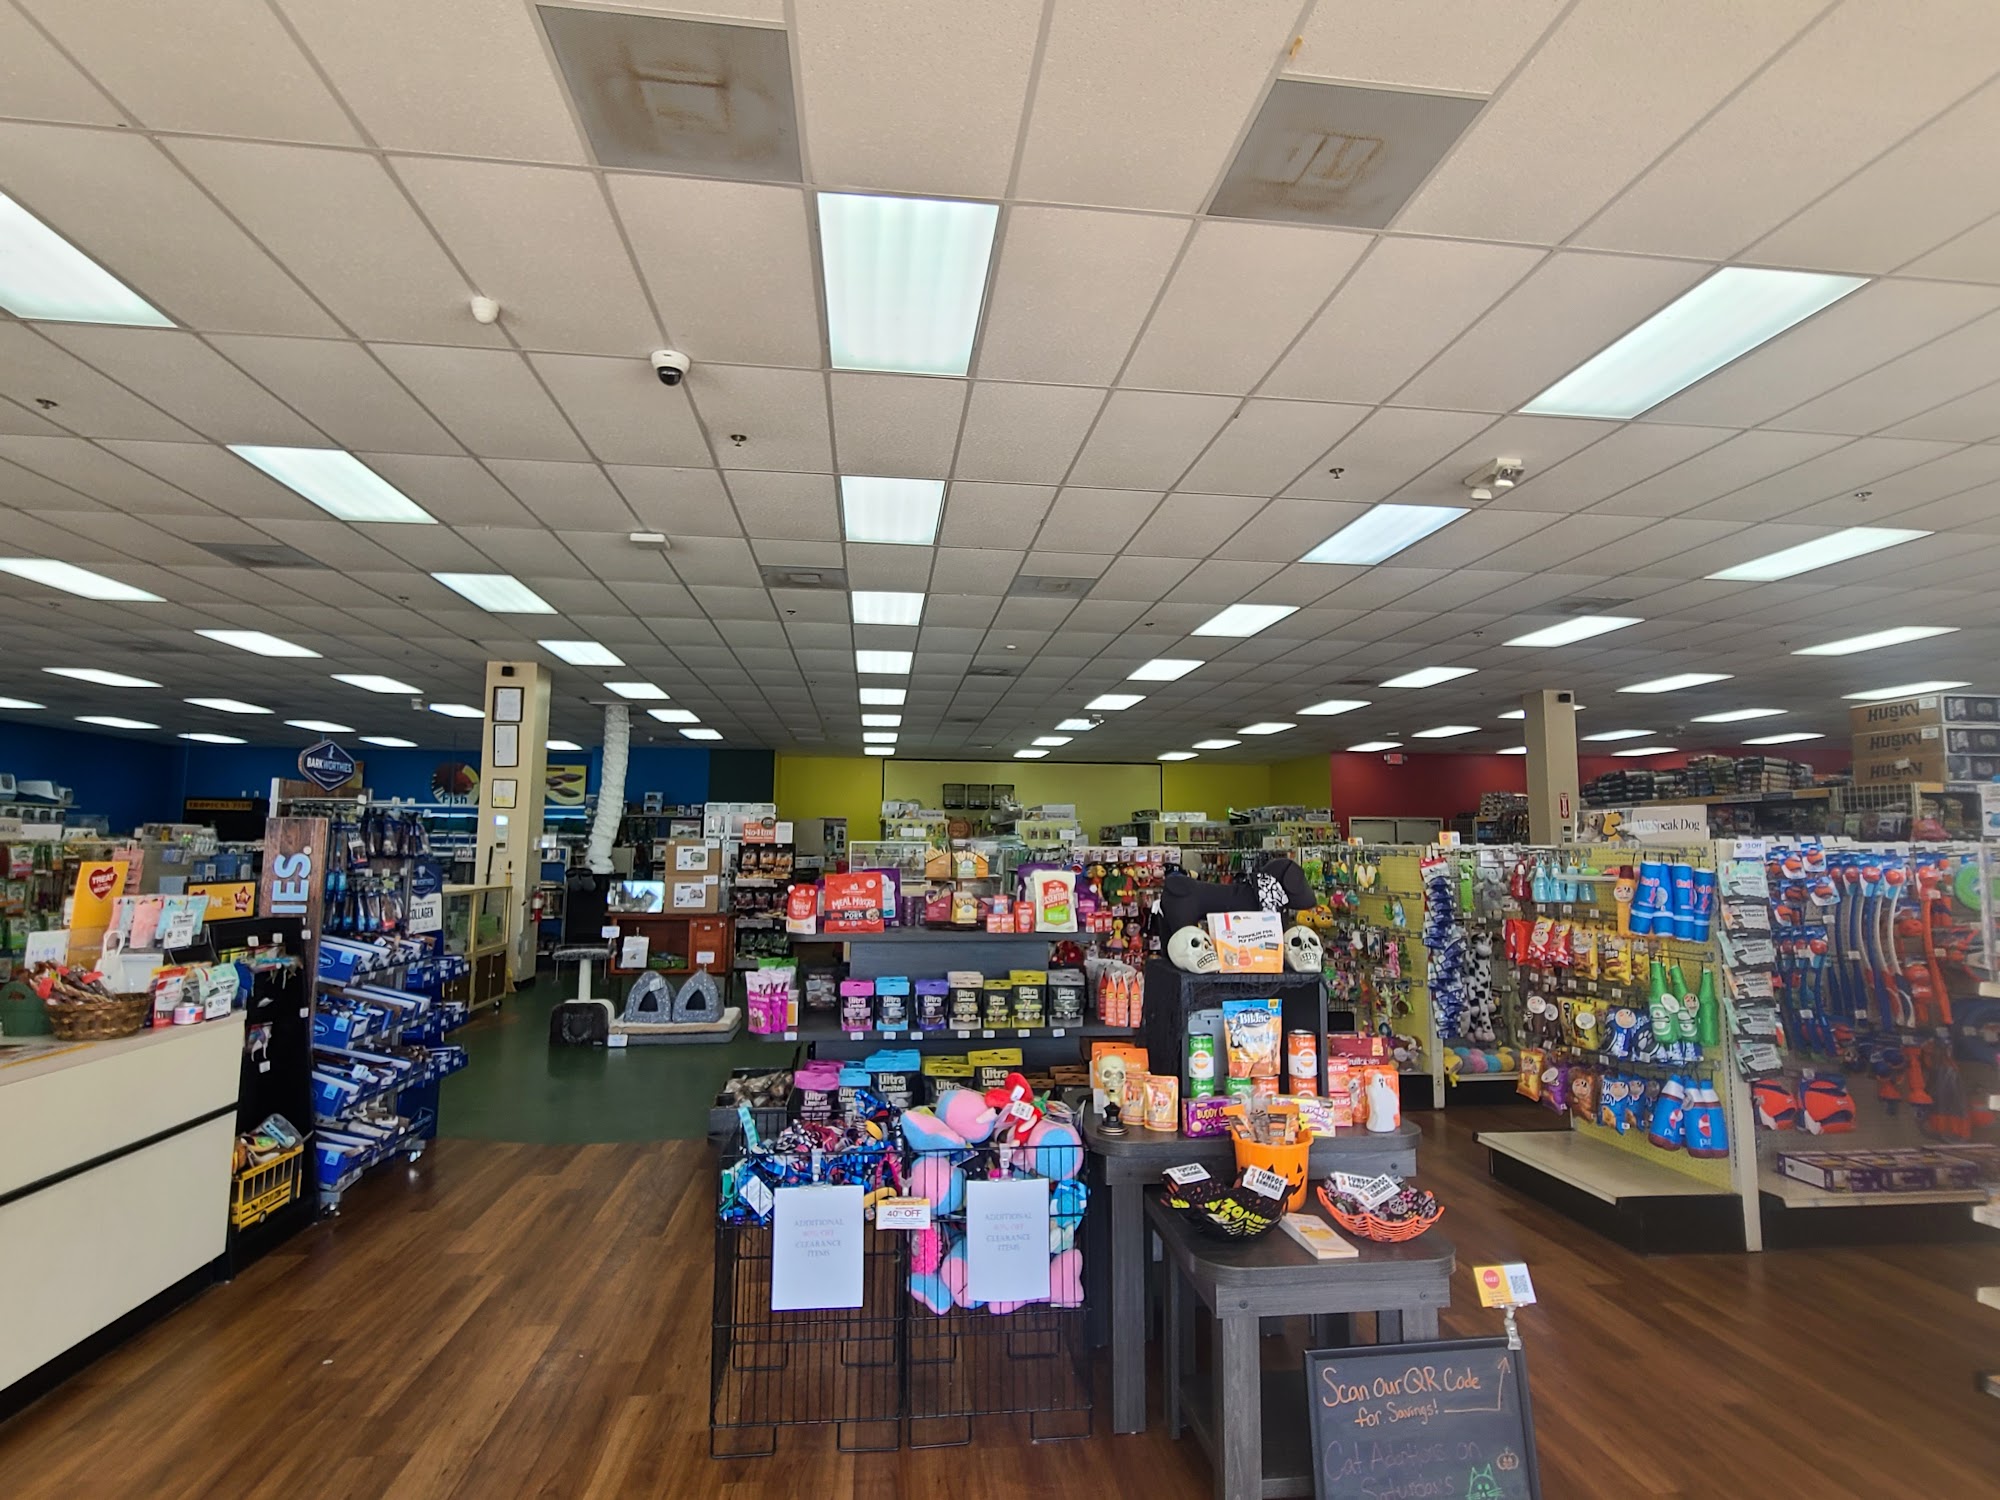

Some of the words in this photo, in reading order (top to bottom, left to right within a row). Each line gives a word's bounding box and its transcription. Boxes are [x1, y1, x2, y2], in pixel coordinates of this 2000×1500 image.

[1868, 703, 1920, 722] HUSKY
[1870, 732, 1922, 751] HUSKY
[306, 757, 353, 774] BARKWORTHIES
[1651, 818, 1679, 833] Speak
[1680, 818, 1700, 832] Dog
[91, 873, 115, 885] TREAT
[831, 896, 852, 910] MEAL
[844, 911, 864, 919] PORK
[1237, 931, 1262, 939] PUMPKIN
[879, 1073, 906, 1085] Ultra
[982, 1067, 1008, 1079] Ultra
[879, 1083, 906, 1092] Limited
[982, 1079, 1005, 1087] Limite
[804, 1090, 828, 1101] Ultra
[839, 1087, 855, 1097] Ultr
[1197, 1107, 1218, 1119] BUDDY
[1258, 1170, 1284, 1187] FUNDOG
[904, 1210, 922, 1218] OFF
[985, 1212, 1033, 1221] ADDITIONAL
[794, 1218, 844, 1227] ADDITIONAL
[986, 1233, 1031, 1243] CLEARANCE
[795, 1240, 841, 1249] CLEARANCE
[807, 1250, 831, 1258] ITEMS
[1322, 1366, 1370, 1408] Scan
[1403, 1365, 1442, 1395] QR
[1443, 1367, 1481, 1392] Code
[1354, 1407, 1381, 1428] for
[1386, 1398, 1439, 1425] Savings!
[1324, 1440, 1362, 1481] Cat
[1457, 1441, 1483, 1461] on
